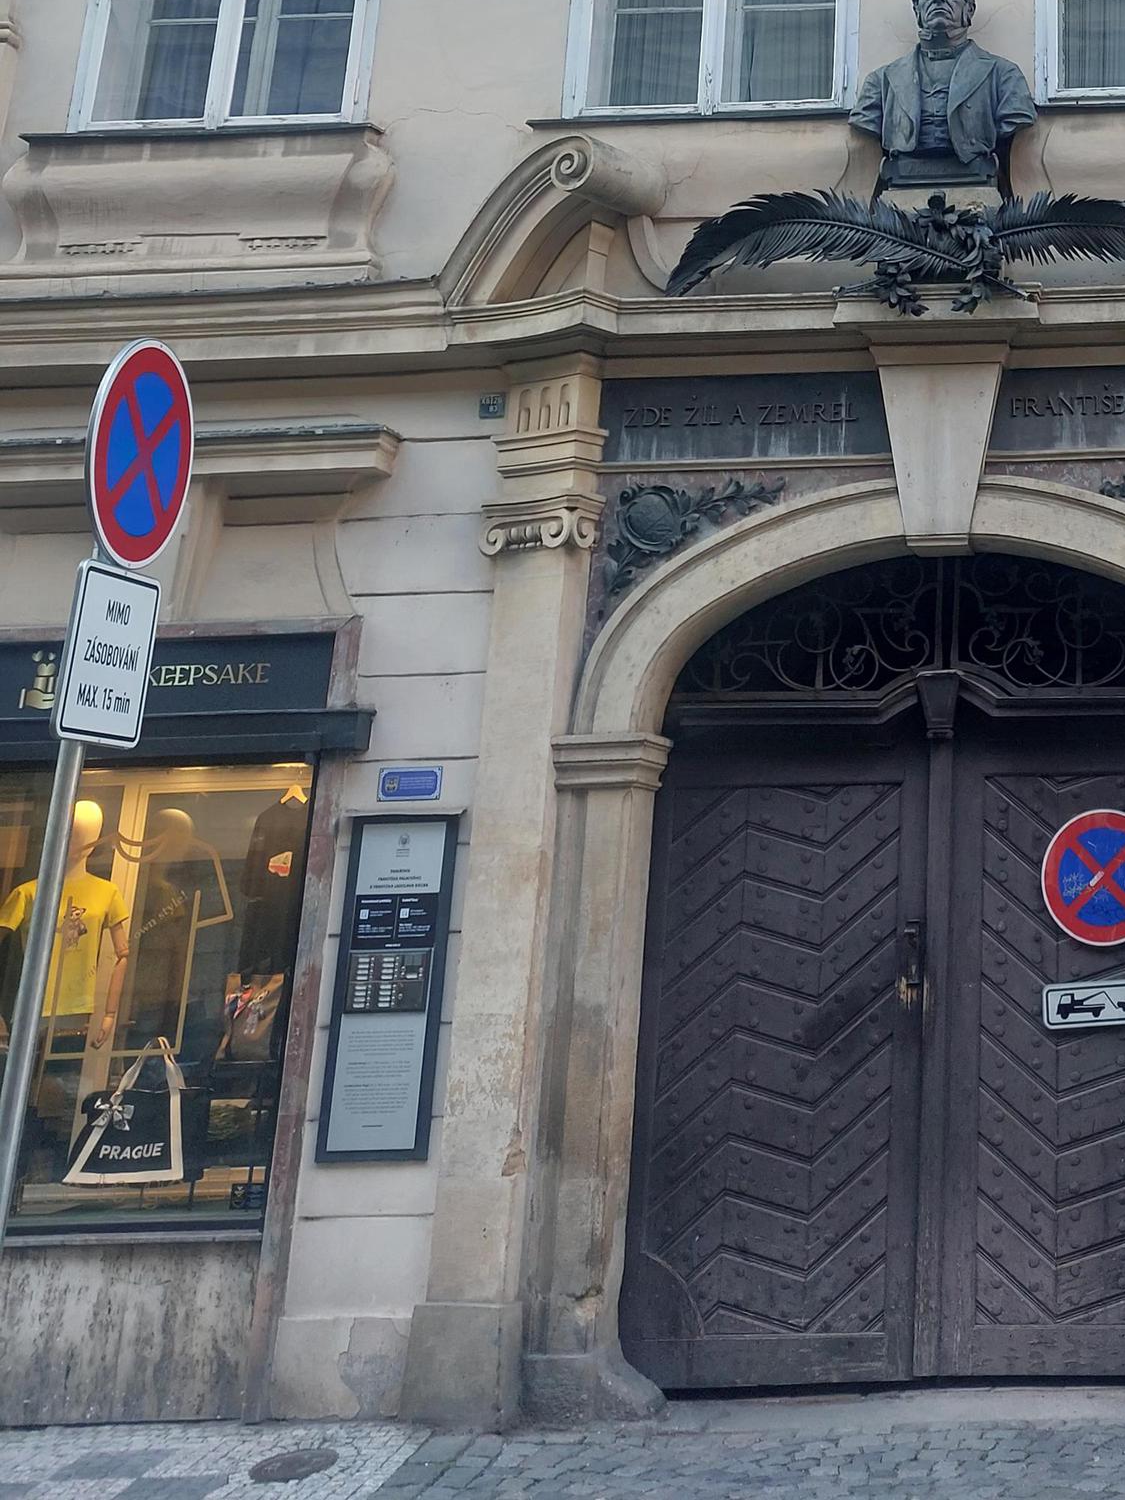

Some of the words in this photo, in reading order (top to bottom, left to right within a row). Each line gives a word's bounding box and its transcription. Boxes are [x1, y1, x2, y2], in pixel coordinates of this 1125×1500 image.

[624, 406, 672, 428] ZDE
[684, 395, 720, 427] ŽIL
[729, 404, 746, 425] A
[758, 391, 857, 426] ZEMŘEL
[105, 599, 131, 626] MIMO
[84, 636, 141, 672] ZÁSOBOVÁNÍ
[150, 663, 271, 687] KEEPSAKE
[76, 683, 98, 708] MAX.
[102, 688, 113, 711] 15
[113, 692, 130, 714] min
[99, 1142, 165, 1160] PRAGUE
